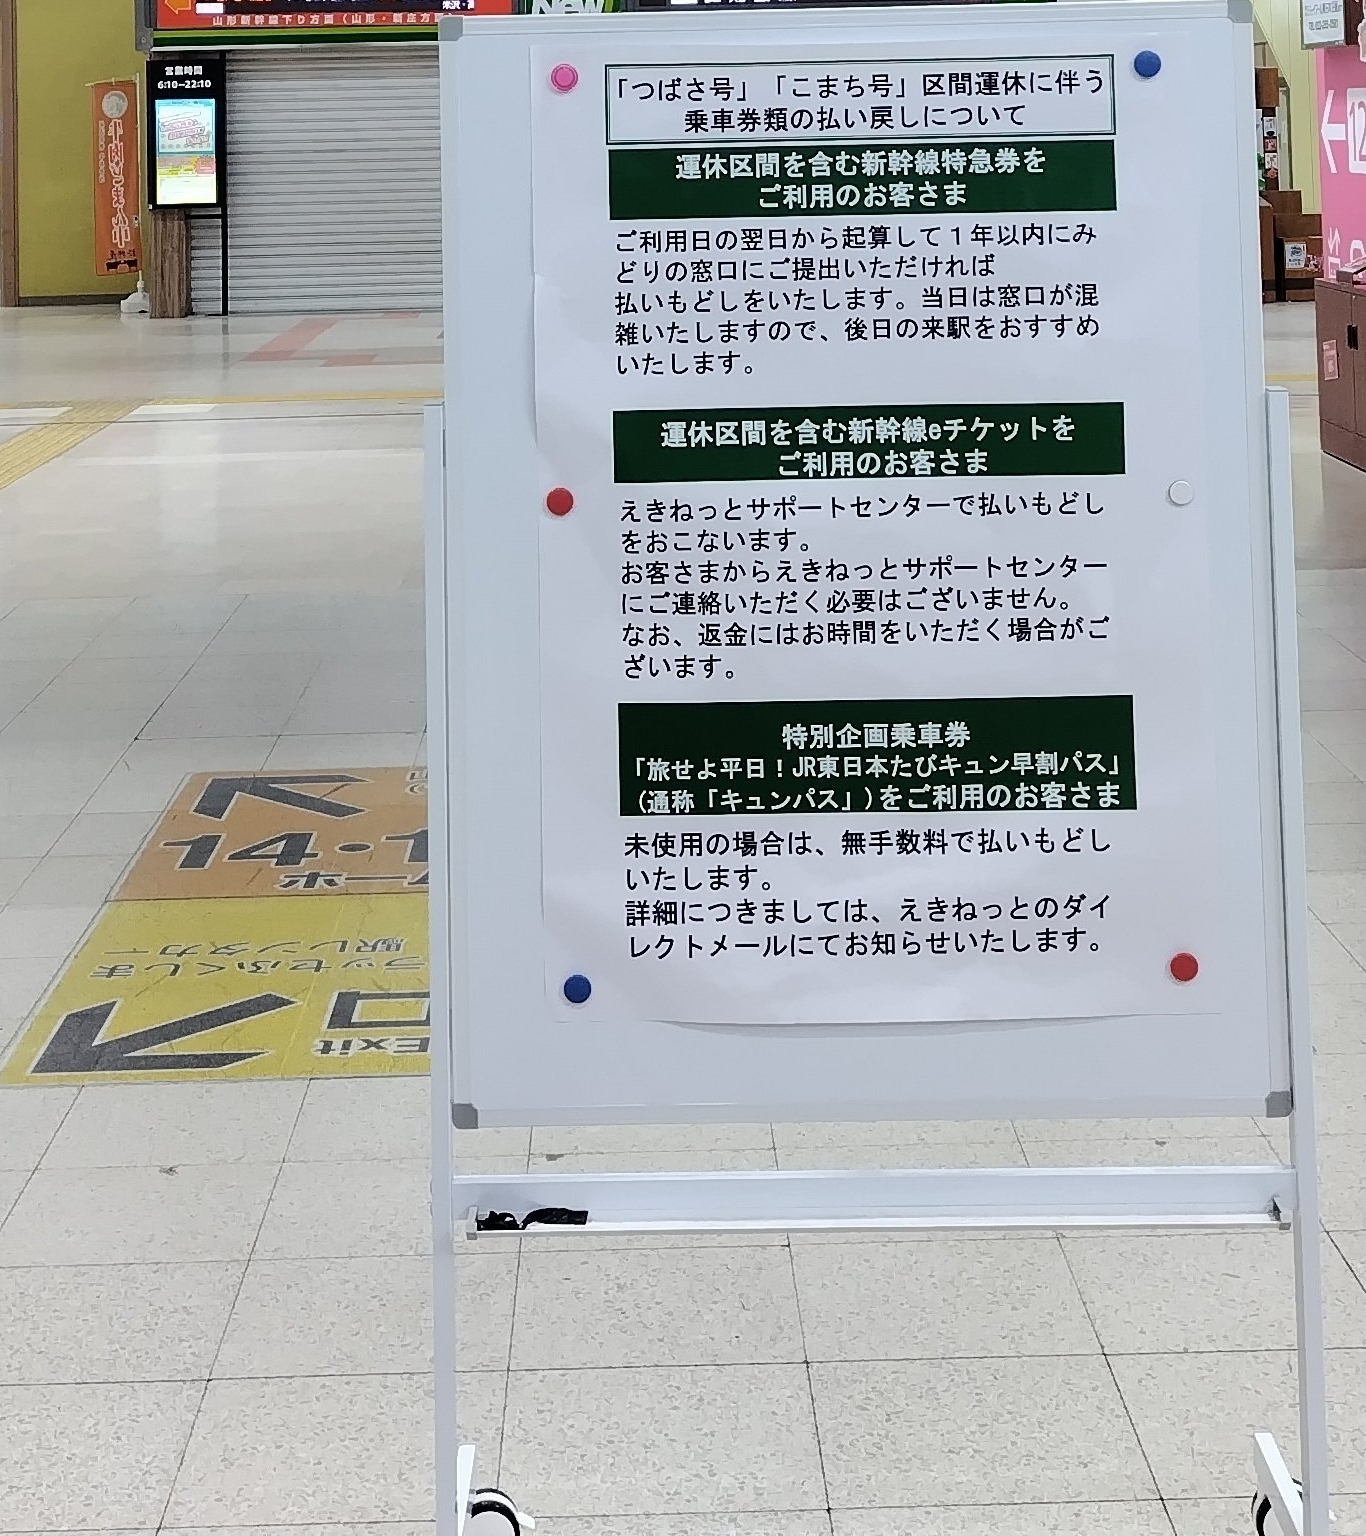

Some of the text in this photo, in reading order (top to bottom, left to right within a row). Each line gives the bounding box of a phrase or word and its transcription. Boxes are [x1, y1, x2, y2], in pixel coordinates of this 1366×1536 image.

[684, 103, 1027, 134] 乗車券類の払い戻しについて
[675, 148, 1046, 179] 運休区間を含む新幹線特急券を
[758, 181, 966, 209] ご利用のお客さま
[615, 253, 995, 285] どりの窓口にご提出いただければ
[615, 283, 1099, 315] 払いもどしをいたします。当日は窓口が混
[615, 314, 1099, 346] 雑いたしますので、後日の来駅をおすすめ
[616, 350, 756, 377] いたします。
[661, 415, 1075, 448] 運休区間を含む新幹線eチケットを
[778, 449, 989, 477] ご利用のお客さま
[621, 492, 1105, 522] えきねっとサポートセンターで払いもどし
[621, 527, 811, 554] をおこないます。
[621, 554, 1107, 585] お客さまからえきねっとサポートセンター
[621, 586, 1073, 616] にご連絡いただく必要はございません。
[621, 615, 1110, 648] なお、返金にはお時間をいただく場合がご
[624, 654, 736, 680] ざいます。
[782, 720, 971, 750] 特別企画乗車券
[624, 827, 1111, 858] 未使用の場合は、無手数料で払いもどし
[625, 864, 774, 892] いたします。
[625, 893, 1113, 926] 詳細につきましては、えきねっとのダイ
[627, 927, 1102, 960] レクトメールにてお知らせいたします。
[318, 1037, 430, 1057] Exit
